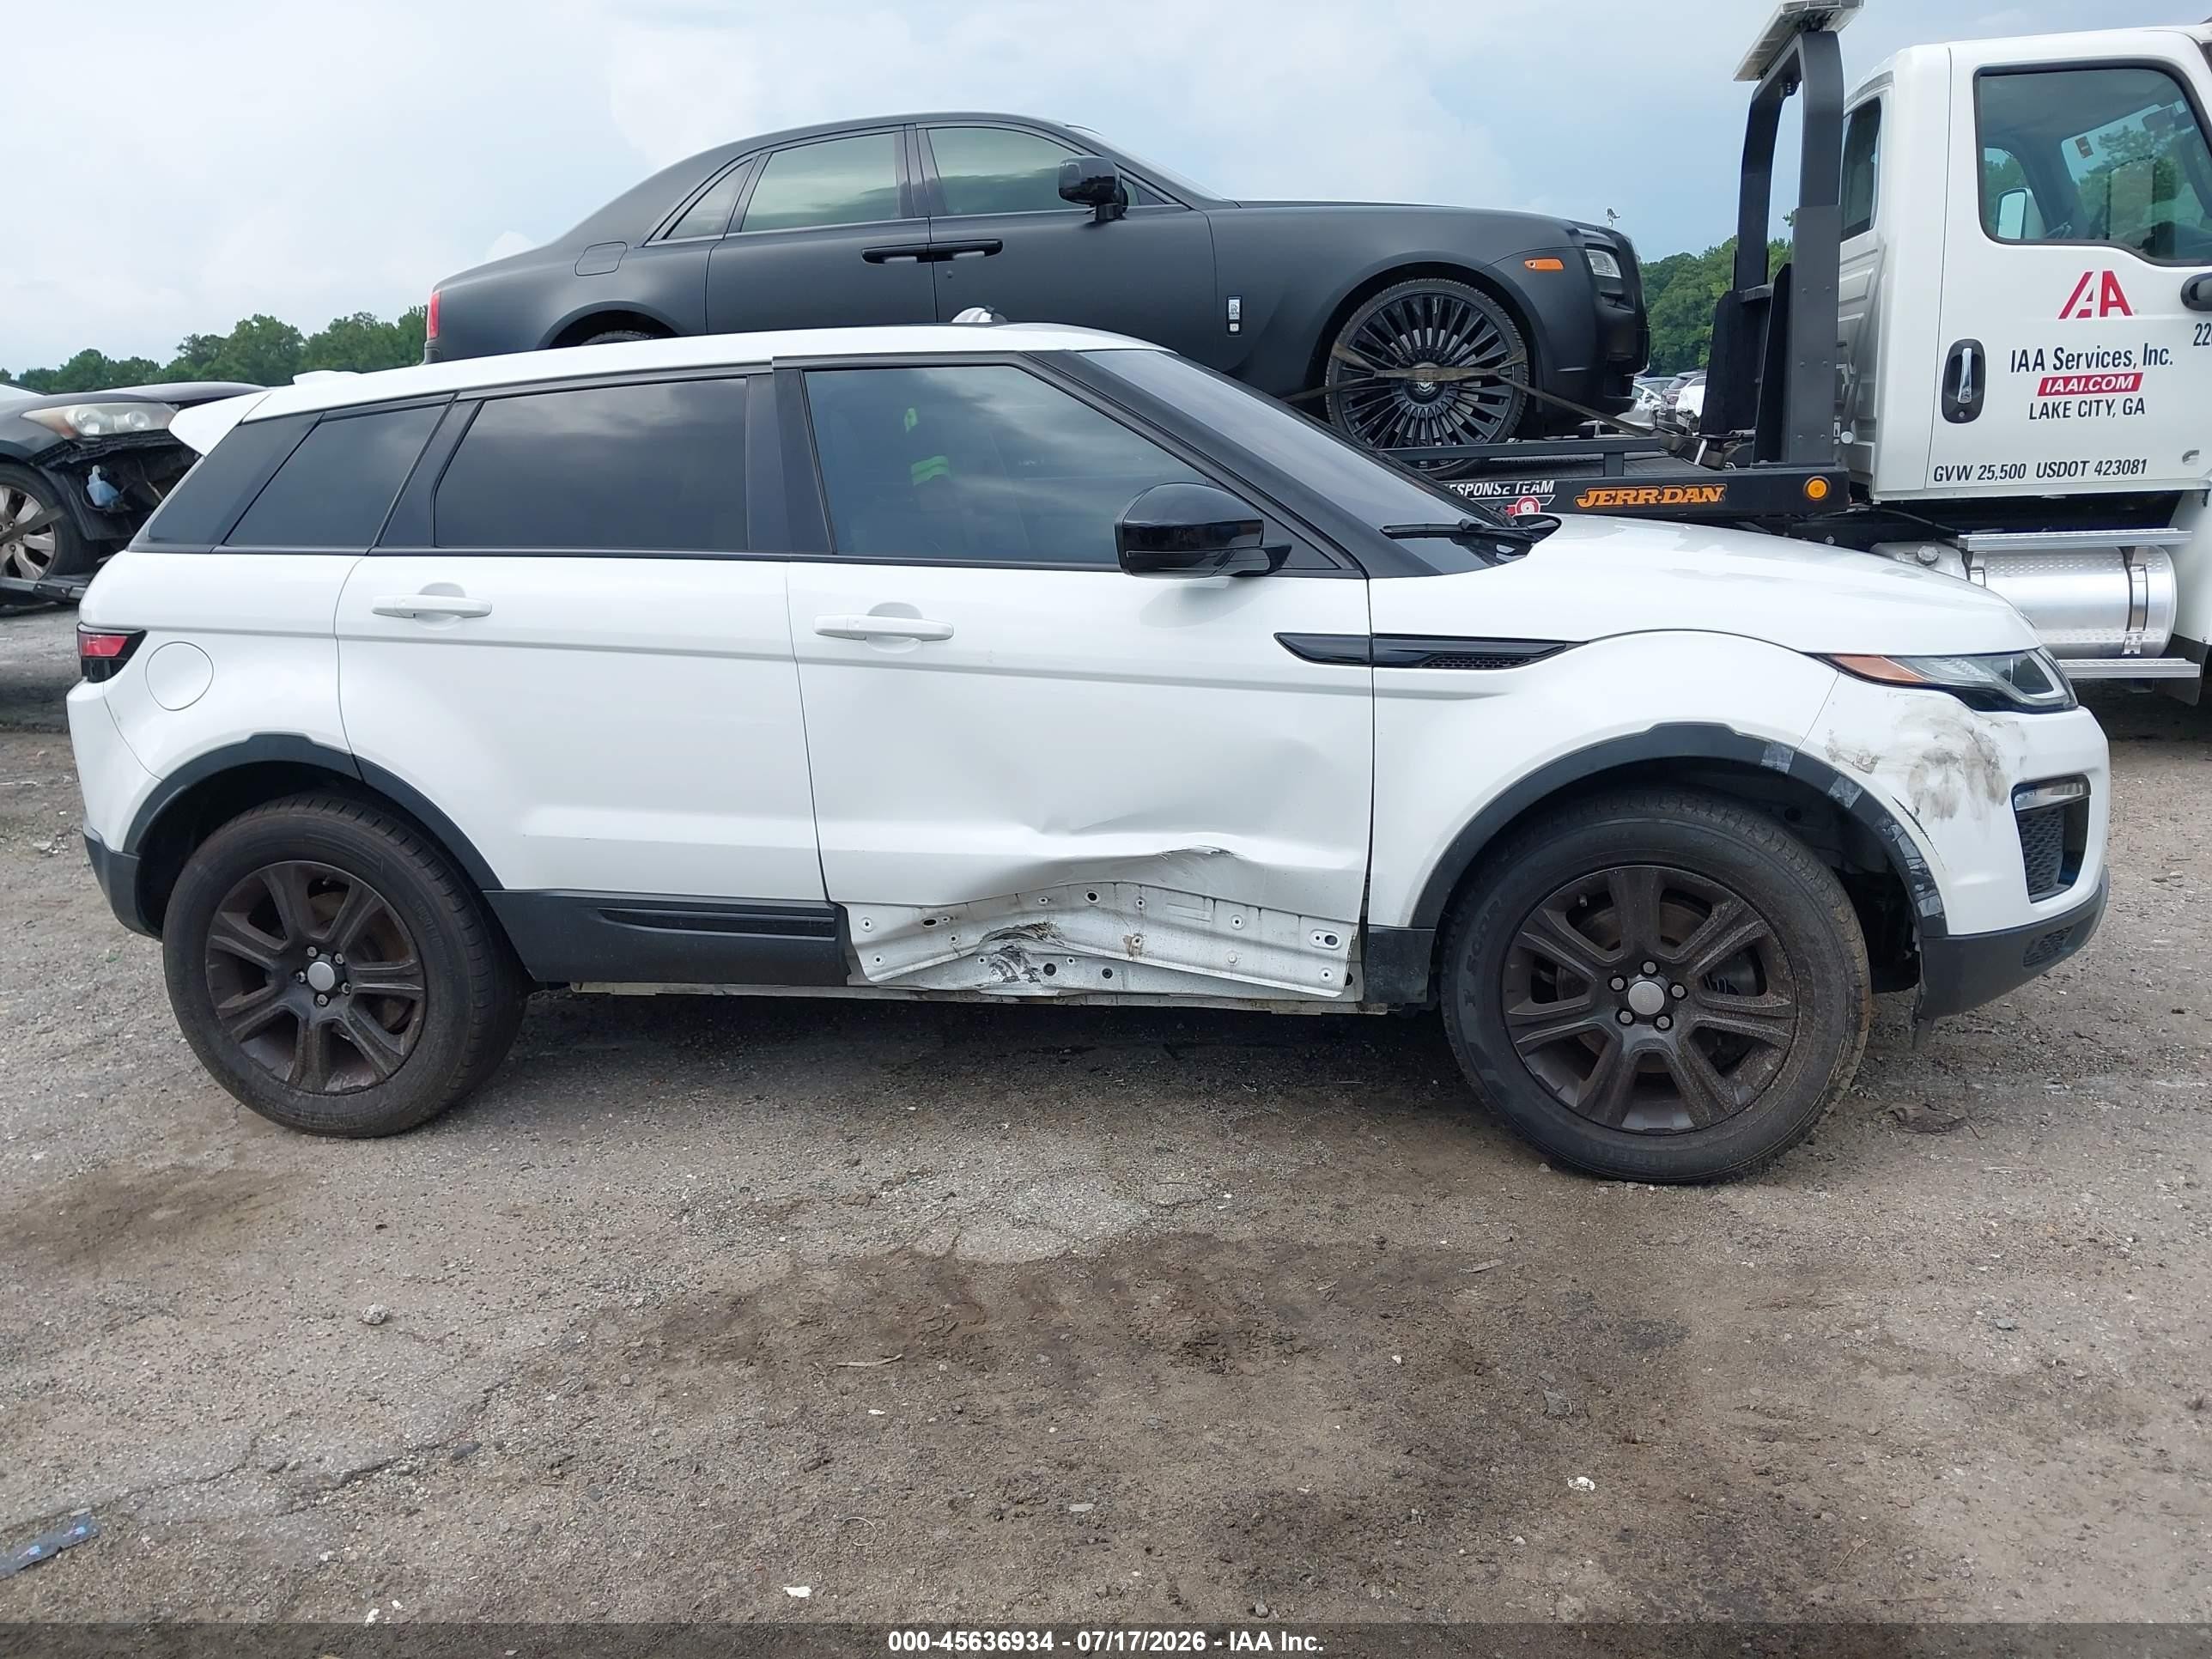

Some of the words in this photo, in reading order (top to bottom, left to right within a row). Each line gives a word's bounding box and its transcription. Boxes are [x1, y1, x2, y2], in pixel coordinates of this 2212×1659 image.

[2193, 322, 2212, 346] 22
[2010, 349, 2045, 373] IAA
[2052, 345, 2136, 371] Services,
[2142, 343, 2173, 366] Inc.
[2045, 375, 2135, 393] IAAI.COM
[2029, 401, 2071, 420] LAKE
[2077, 398, 2116, 417] CITY,
[2123, 398, 2146, 416] GA
[1933, 465, 1974, 482] GVW
[1977, 463, 2027, 482] 25,500
[2036, 460, 2090, 478] USDOT
[2094, 459, 2148, 477] 423081
[1515, 480, 1555, 495] TEAM
